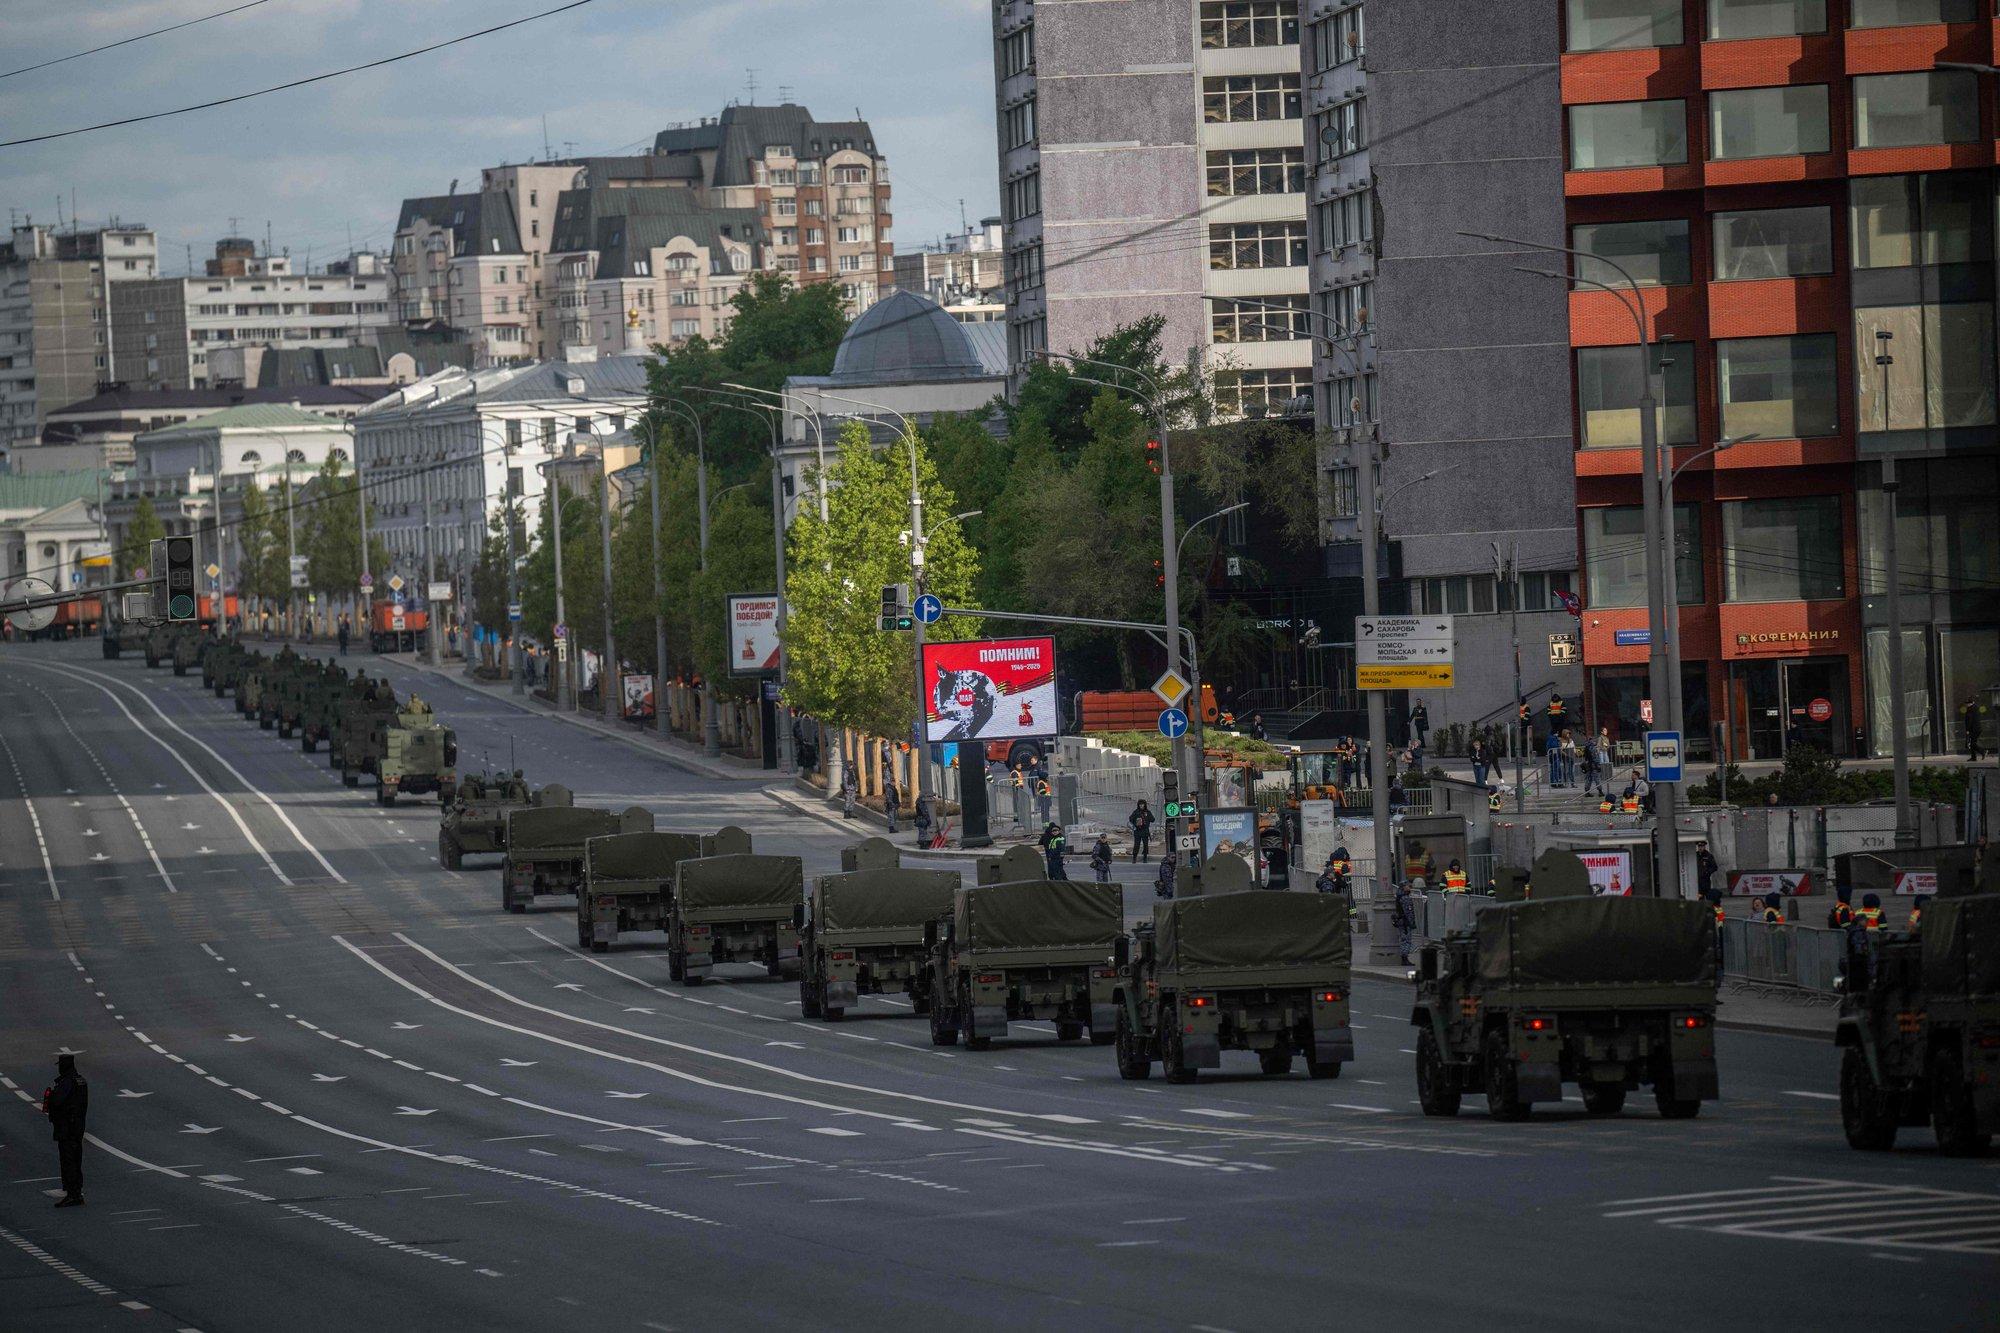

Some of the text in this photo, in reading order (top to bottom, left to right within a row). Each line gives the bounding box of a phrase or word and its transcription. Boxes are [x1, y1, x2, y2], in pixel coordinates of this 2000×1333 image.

[736, 602, 776, 611] ГОРДИМСЯ
[736, 611, 773, 621] ПОБЕДОЙ!
[1750, 630, 1839, 642] КОФЕМАНИЯ
[980, 647, 1039, 662] ПОМНИМ!
